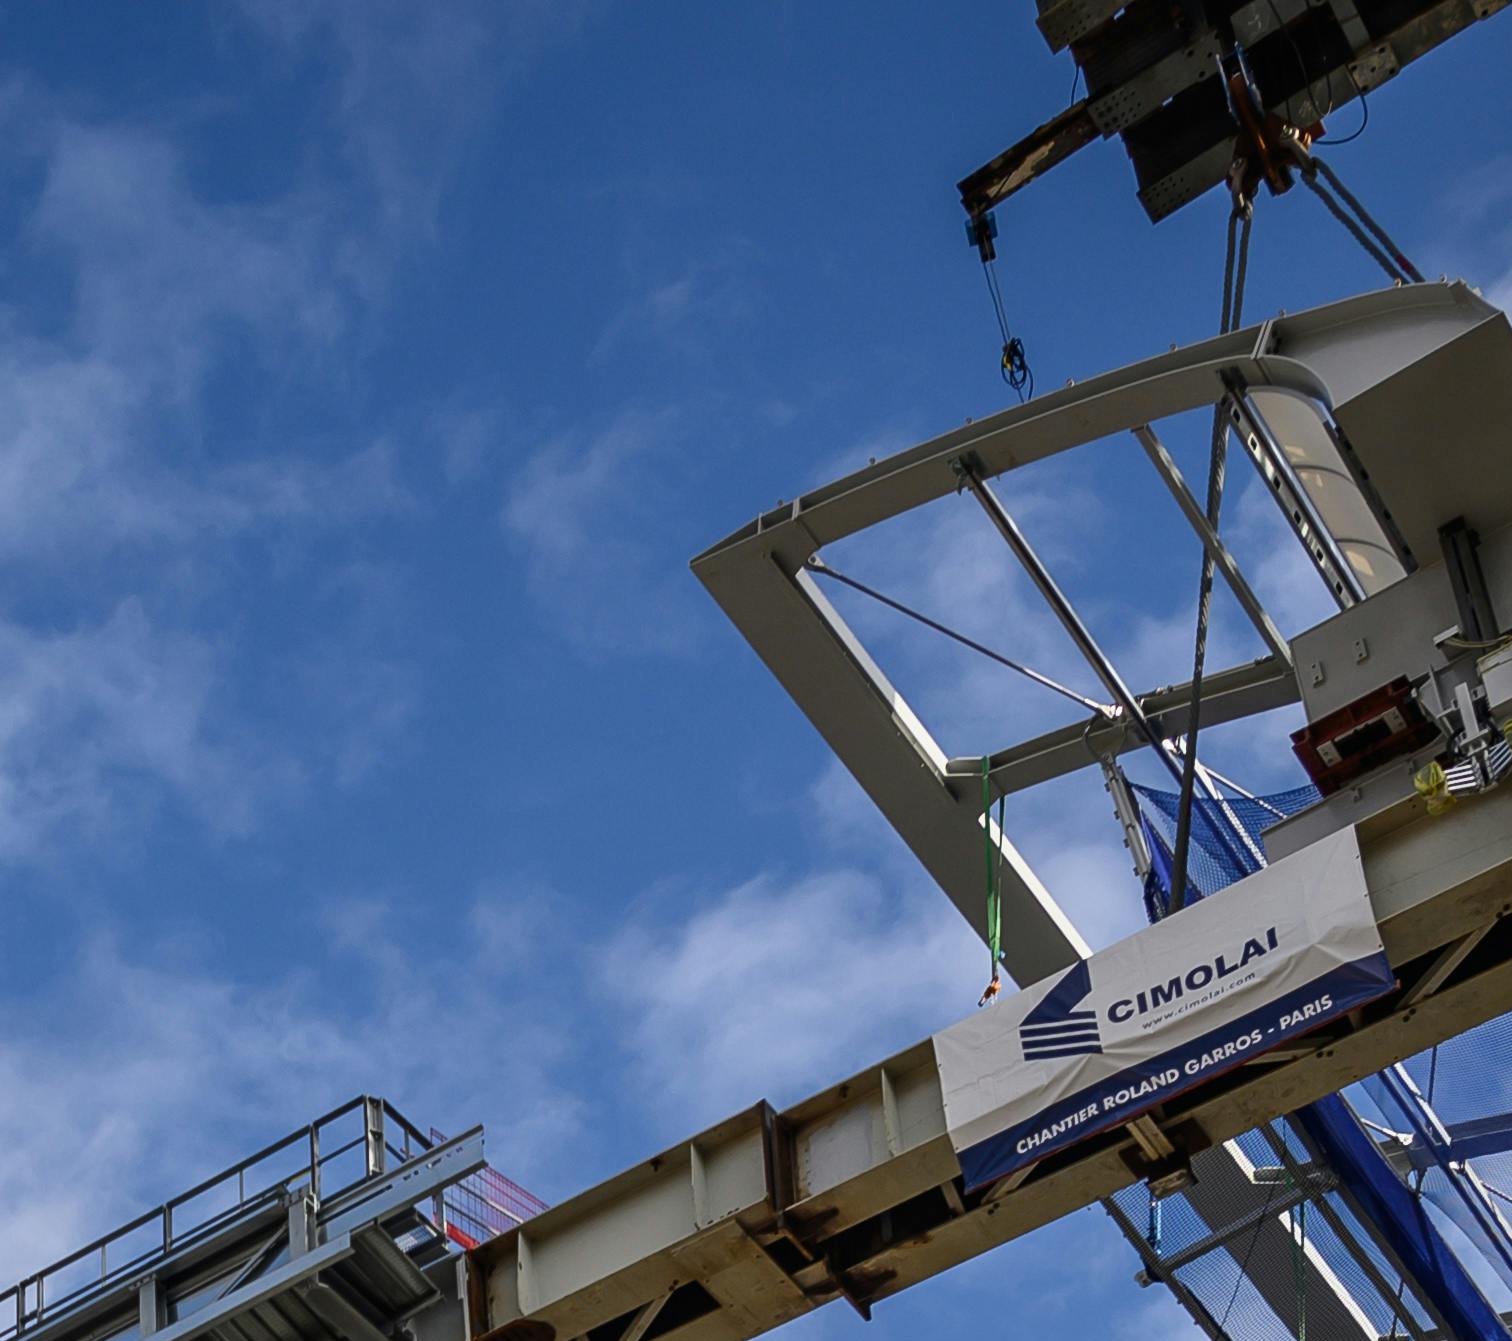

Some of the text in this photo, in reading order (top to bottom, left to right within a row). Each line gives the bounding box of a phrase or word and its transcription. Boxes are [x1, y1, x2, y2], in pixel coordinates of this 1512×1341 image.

[1108, 927, 1279, 1024] CIMOLAI
[1141, 970, 1257, 1031] www.cimolai.com
[1016, 1104, 1099, 1155] CHANTIER
[1103, 1067, 1181, 1111] ROLAND
[1184, 1029, 1263, 1077] GARROS
[1280, 994, 1333, 1029] PARIS
